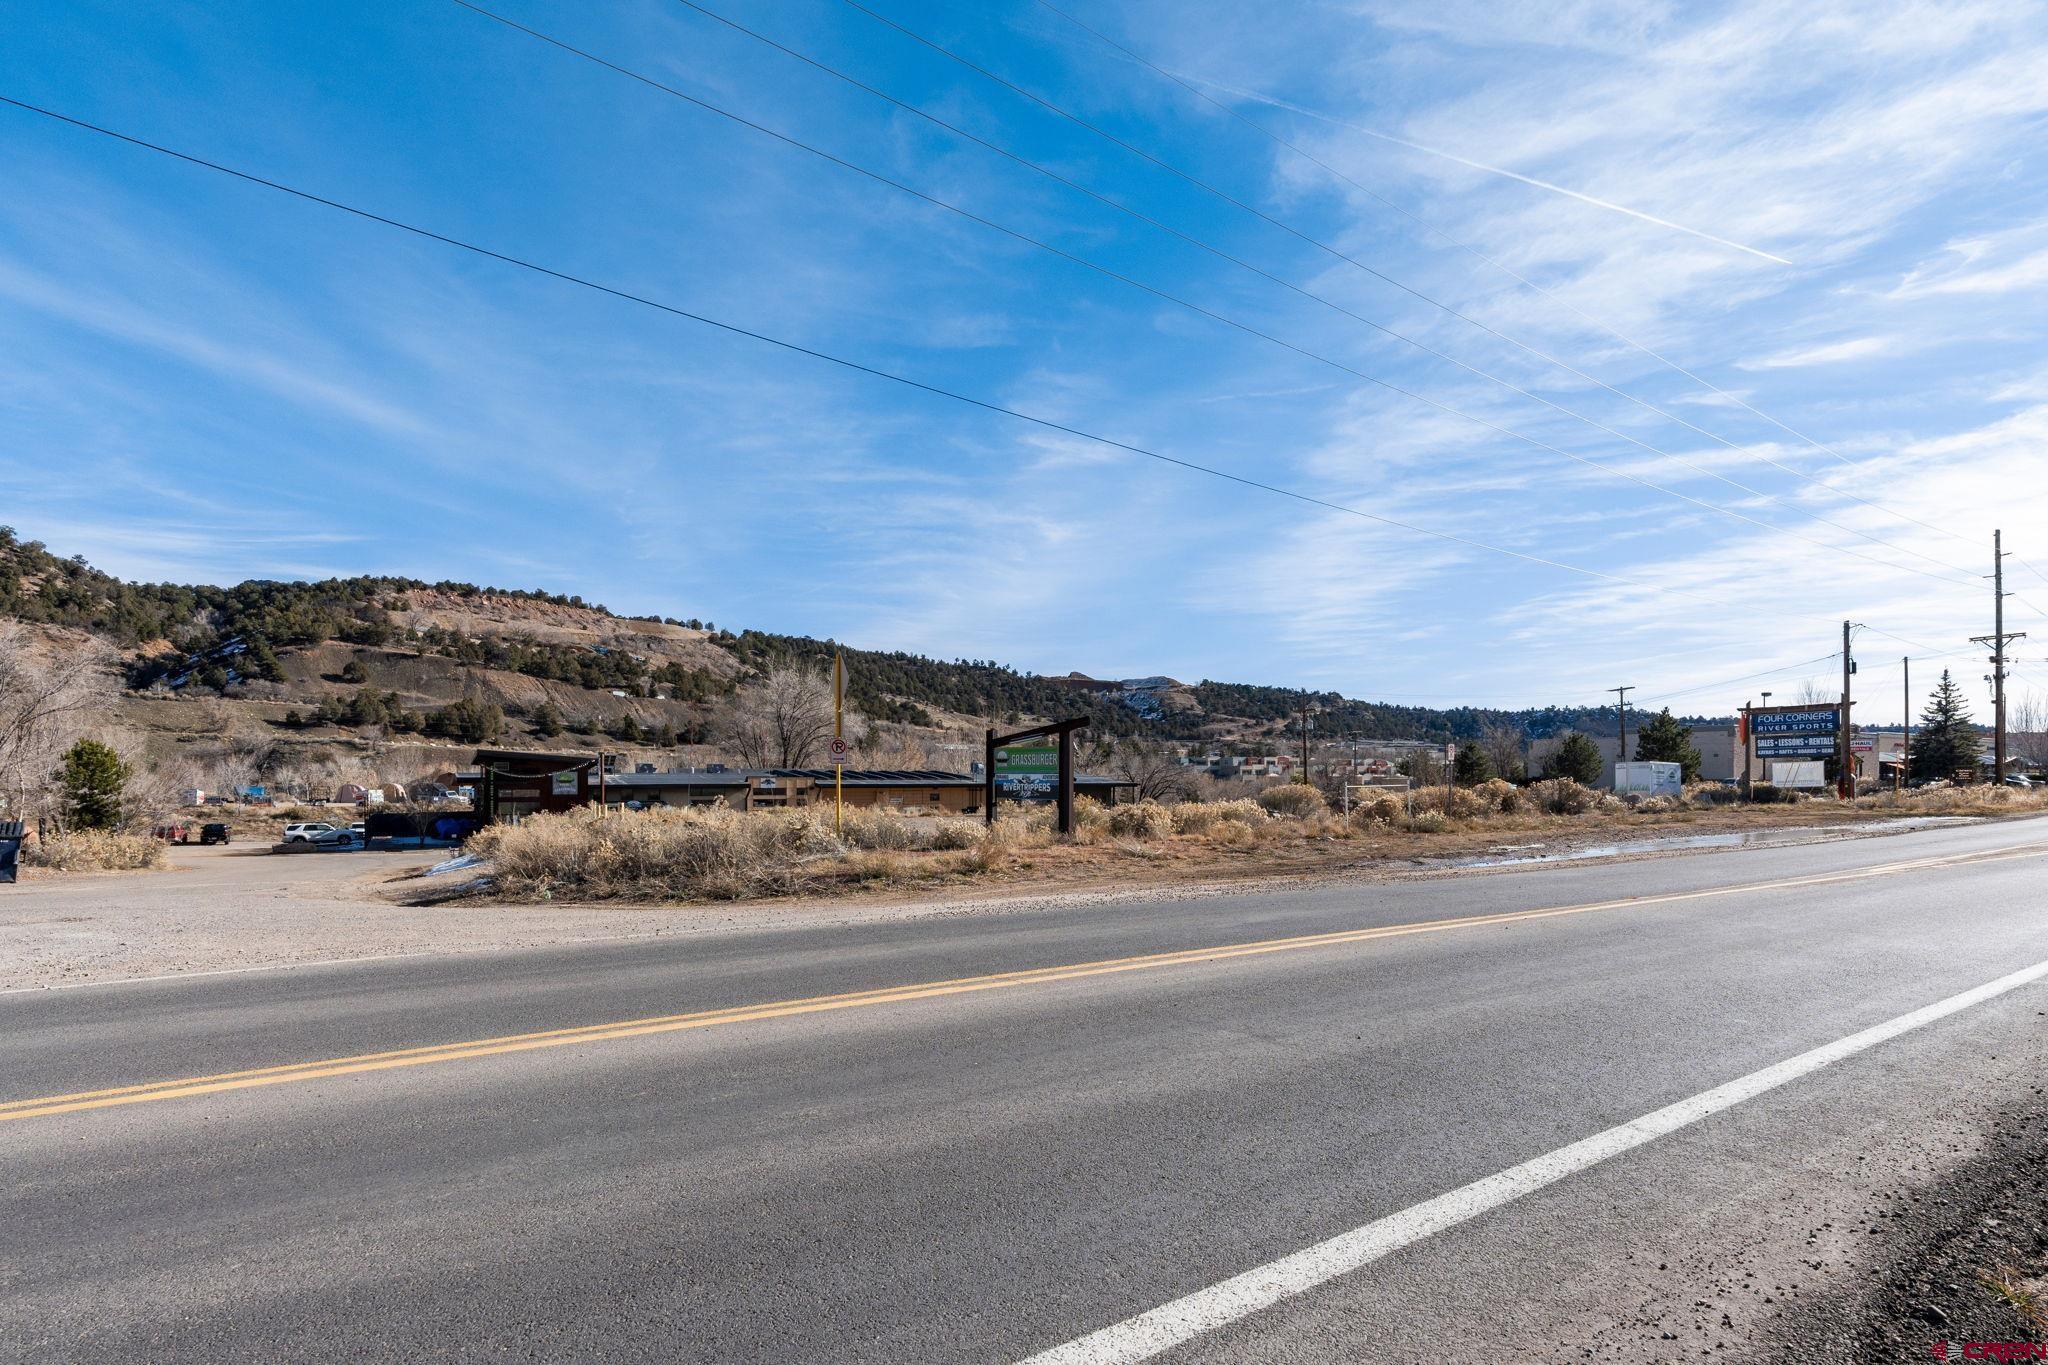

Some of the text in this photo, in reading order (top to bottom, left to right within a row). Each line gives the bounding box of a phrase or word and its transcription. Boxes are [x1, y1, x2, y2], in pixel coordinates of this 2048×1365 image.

[1757, 711, 1833, 723] FOUR CORNERS
[1757, 722, 1833, 732] RIVER SPORTS
[1757, 736, 1834, 747] SALES LESSONS RENTALS
[1011, 753, 1058, 766] GRASSBURGER
[1003, 782, 1051, 792] RIVERTRIPPERS
